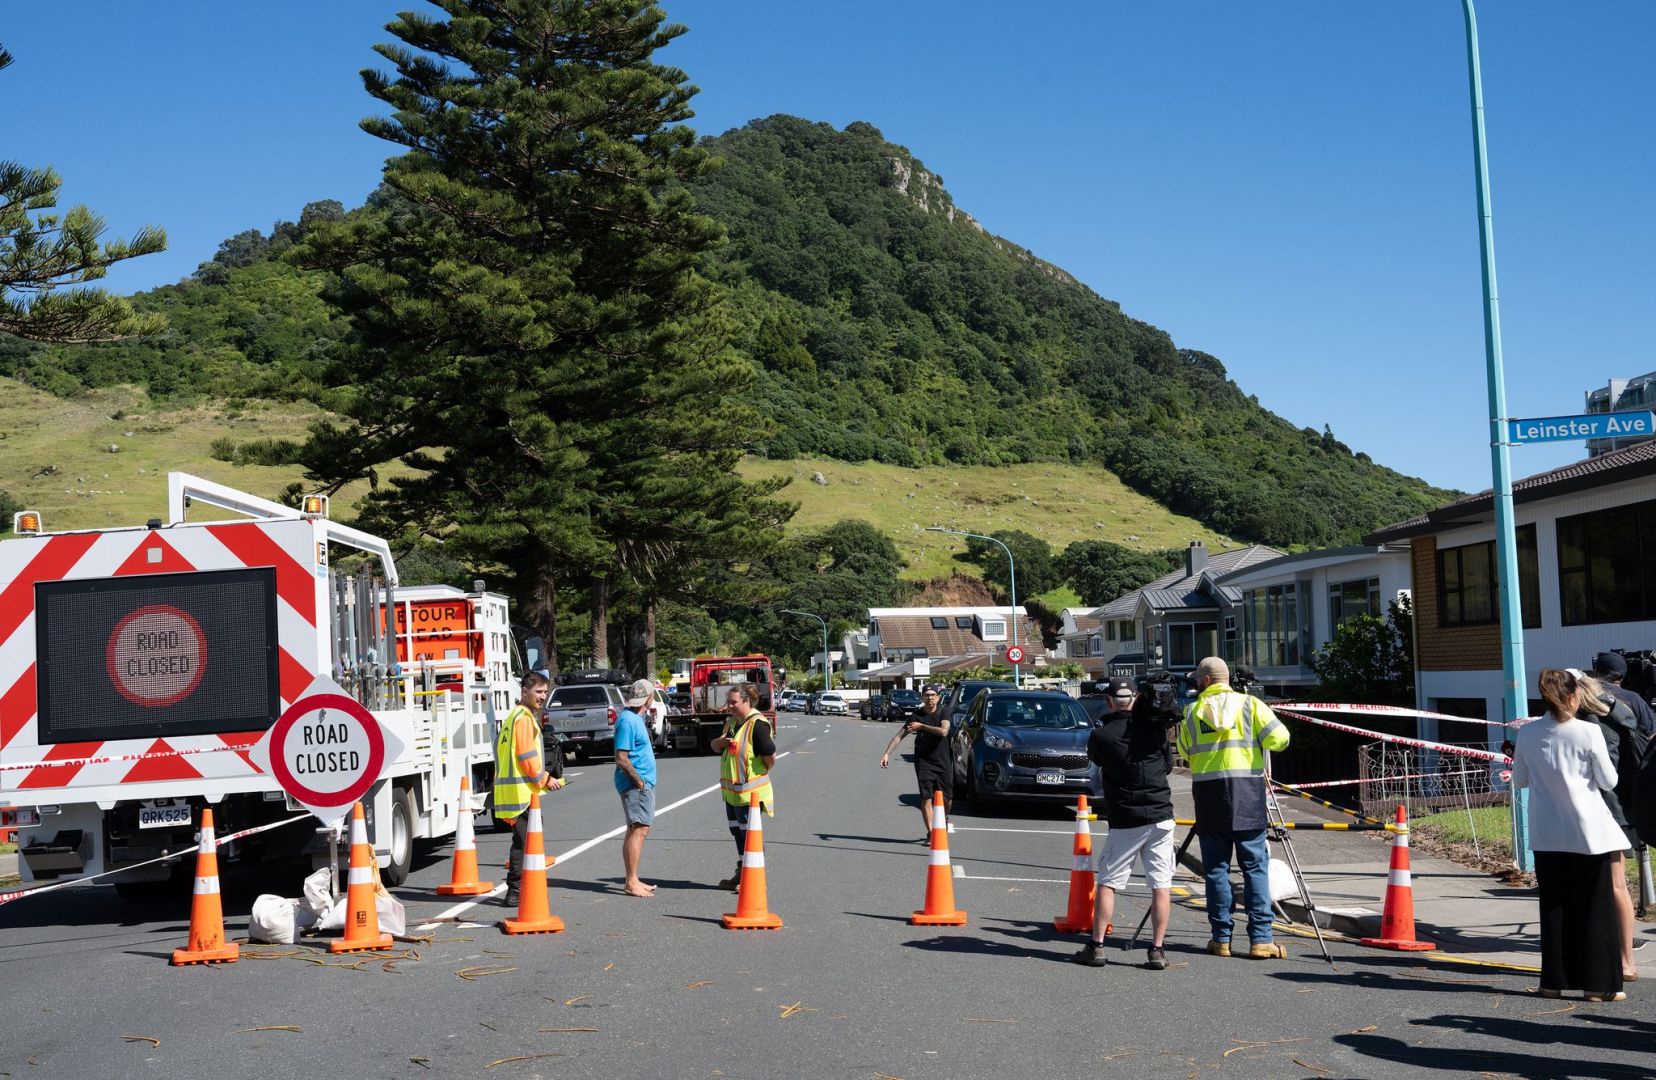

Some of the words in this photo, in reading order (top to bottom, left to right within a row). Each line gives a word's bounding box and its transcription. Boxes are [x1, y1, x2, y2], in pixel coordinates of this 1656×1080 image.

[1516, 420, 1598, 440] Leinster
[1606, 416, 1646, 433] Ave
[385, 608, 455, 623] ETOUR
[137, 630, 178, 651] ROAD
[127, 655, 189, 677] CLOSED
[303, 723, 348, 745] ROAD
[296, 751, 359, 775] CLOSED
[142, 808, 189, 824] QRK525
